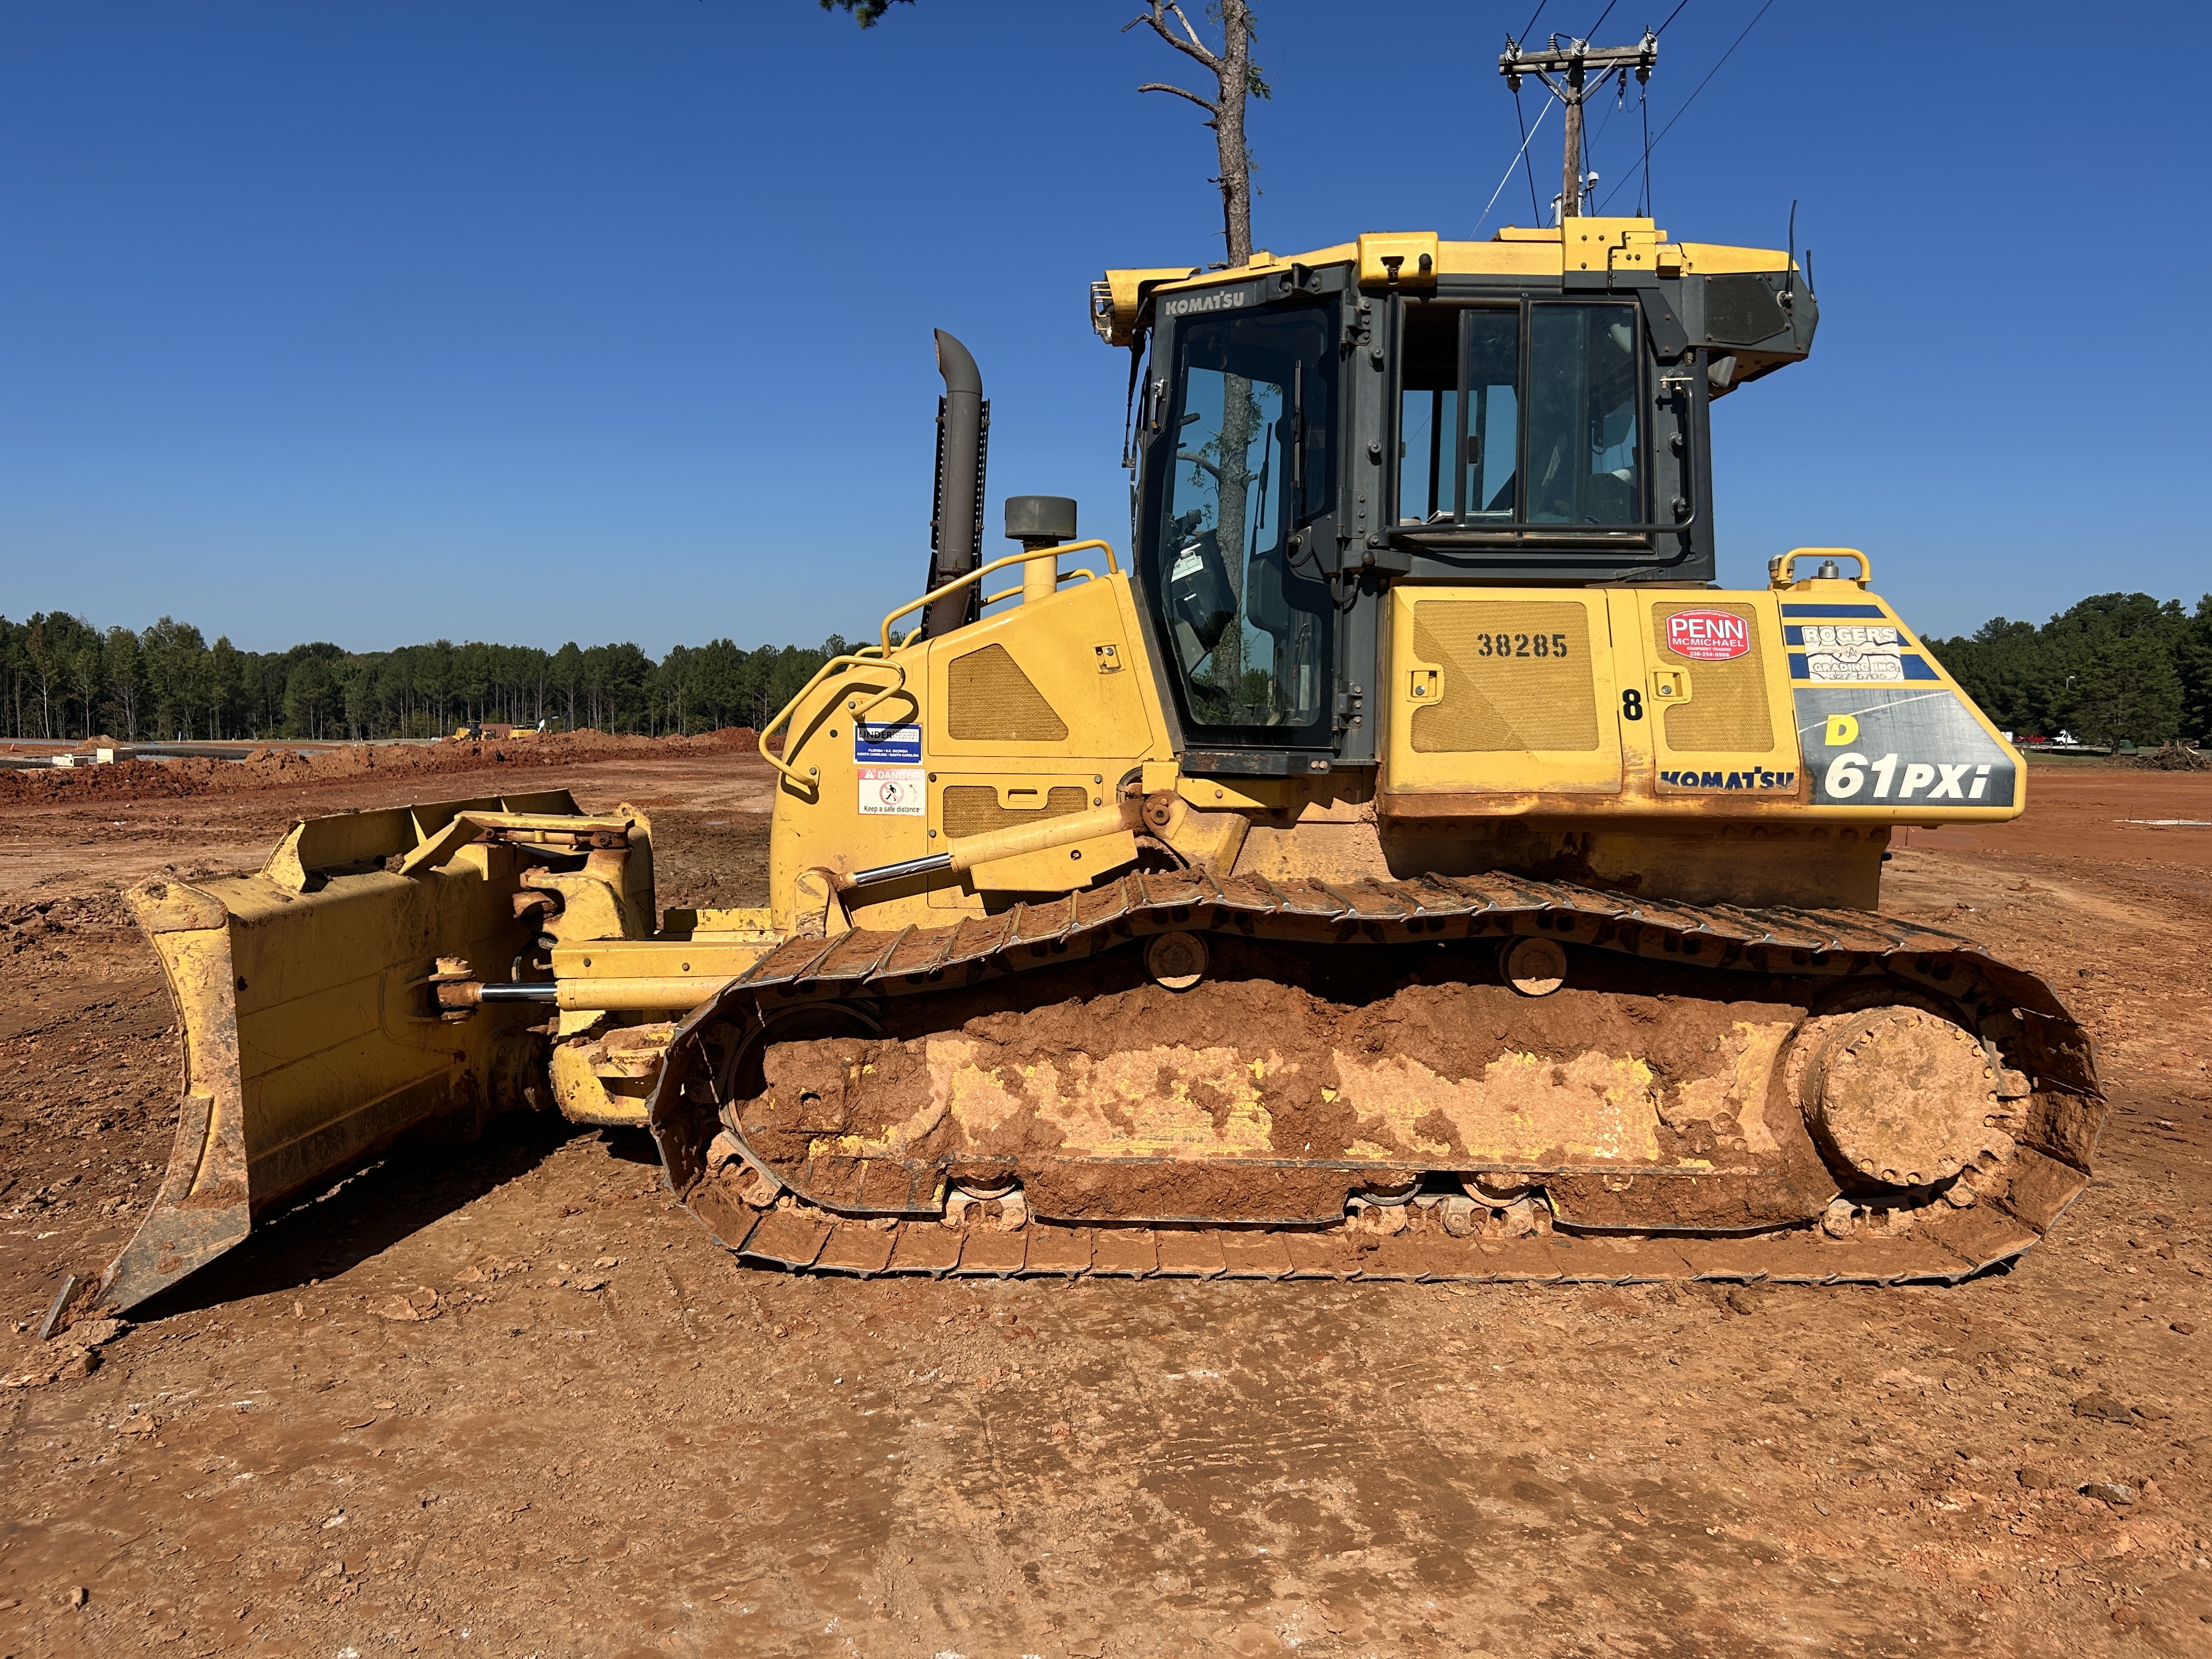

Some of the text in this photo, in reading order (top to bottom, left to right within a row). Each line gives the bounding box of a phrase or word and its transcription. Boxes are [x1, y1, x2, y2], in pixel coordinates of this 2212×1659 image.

[1166, 291, 1244, 315] KOMATSU
[1671, 618, 1744, 639] PENN
[1803, 628, 1897, 642] ROGERS
[1477, 634, 1567, 657] 38285
[1672, 638, 1745, 647] MCMICHAEL
[1813, 663, 1870, 673] GRADING
[1622, 689, 1643, 720] 8
[859, 730, 893, 739] LINDER
[1825, 714, 1859, 746] D
[1661, 766, 1794, 790] KOMATSU
[1825, 753, 1991, 798] 61PXi
[864, 805, 878, 814] Keep
